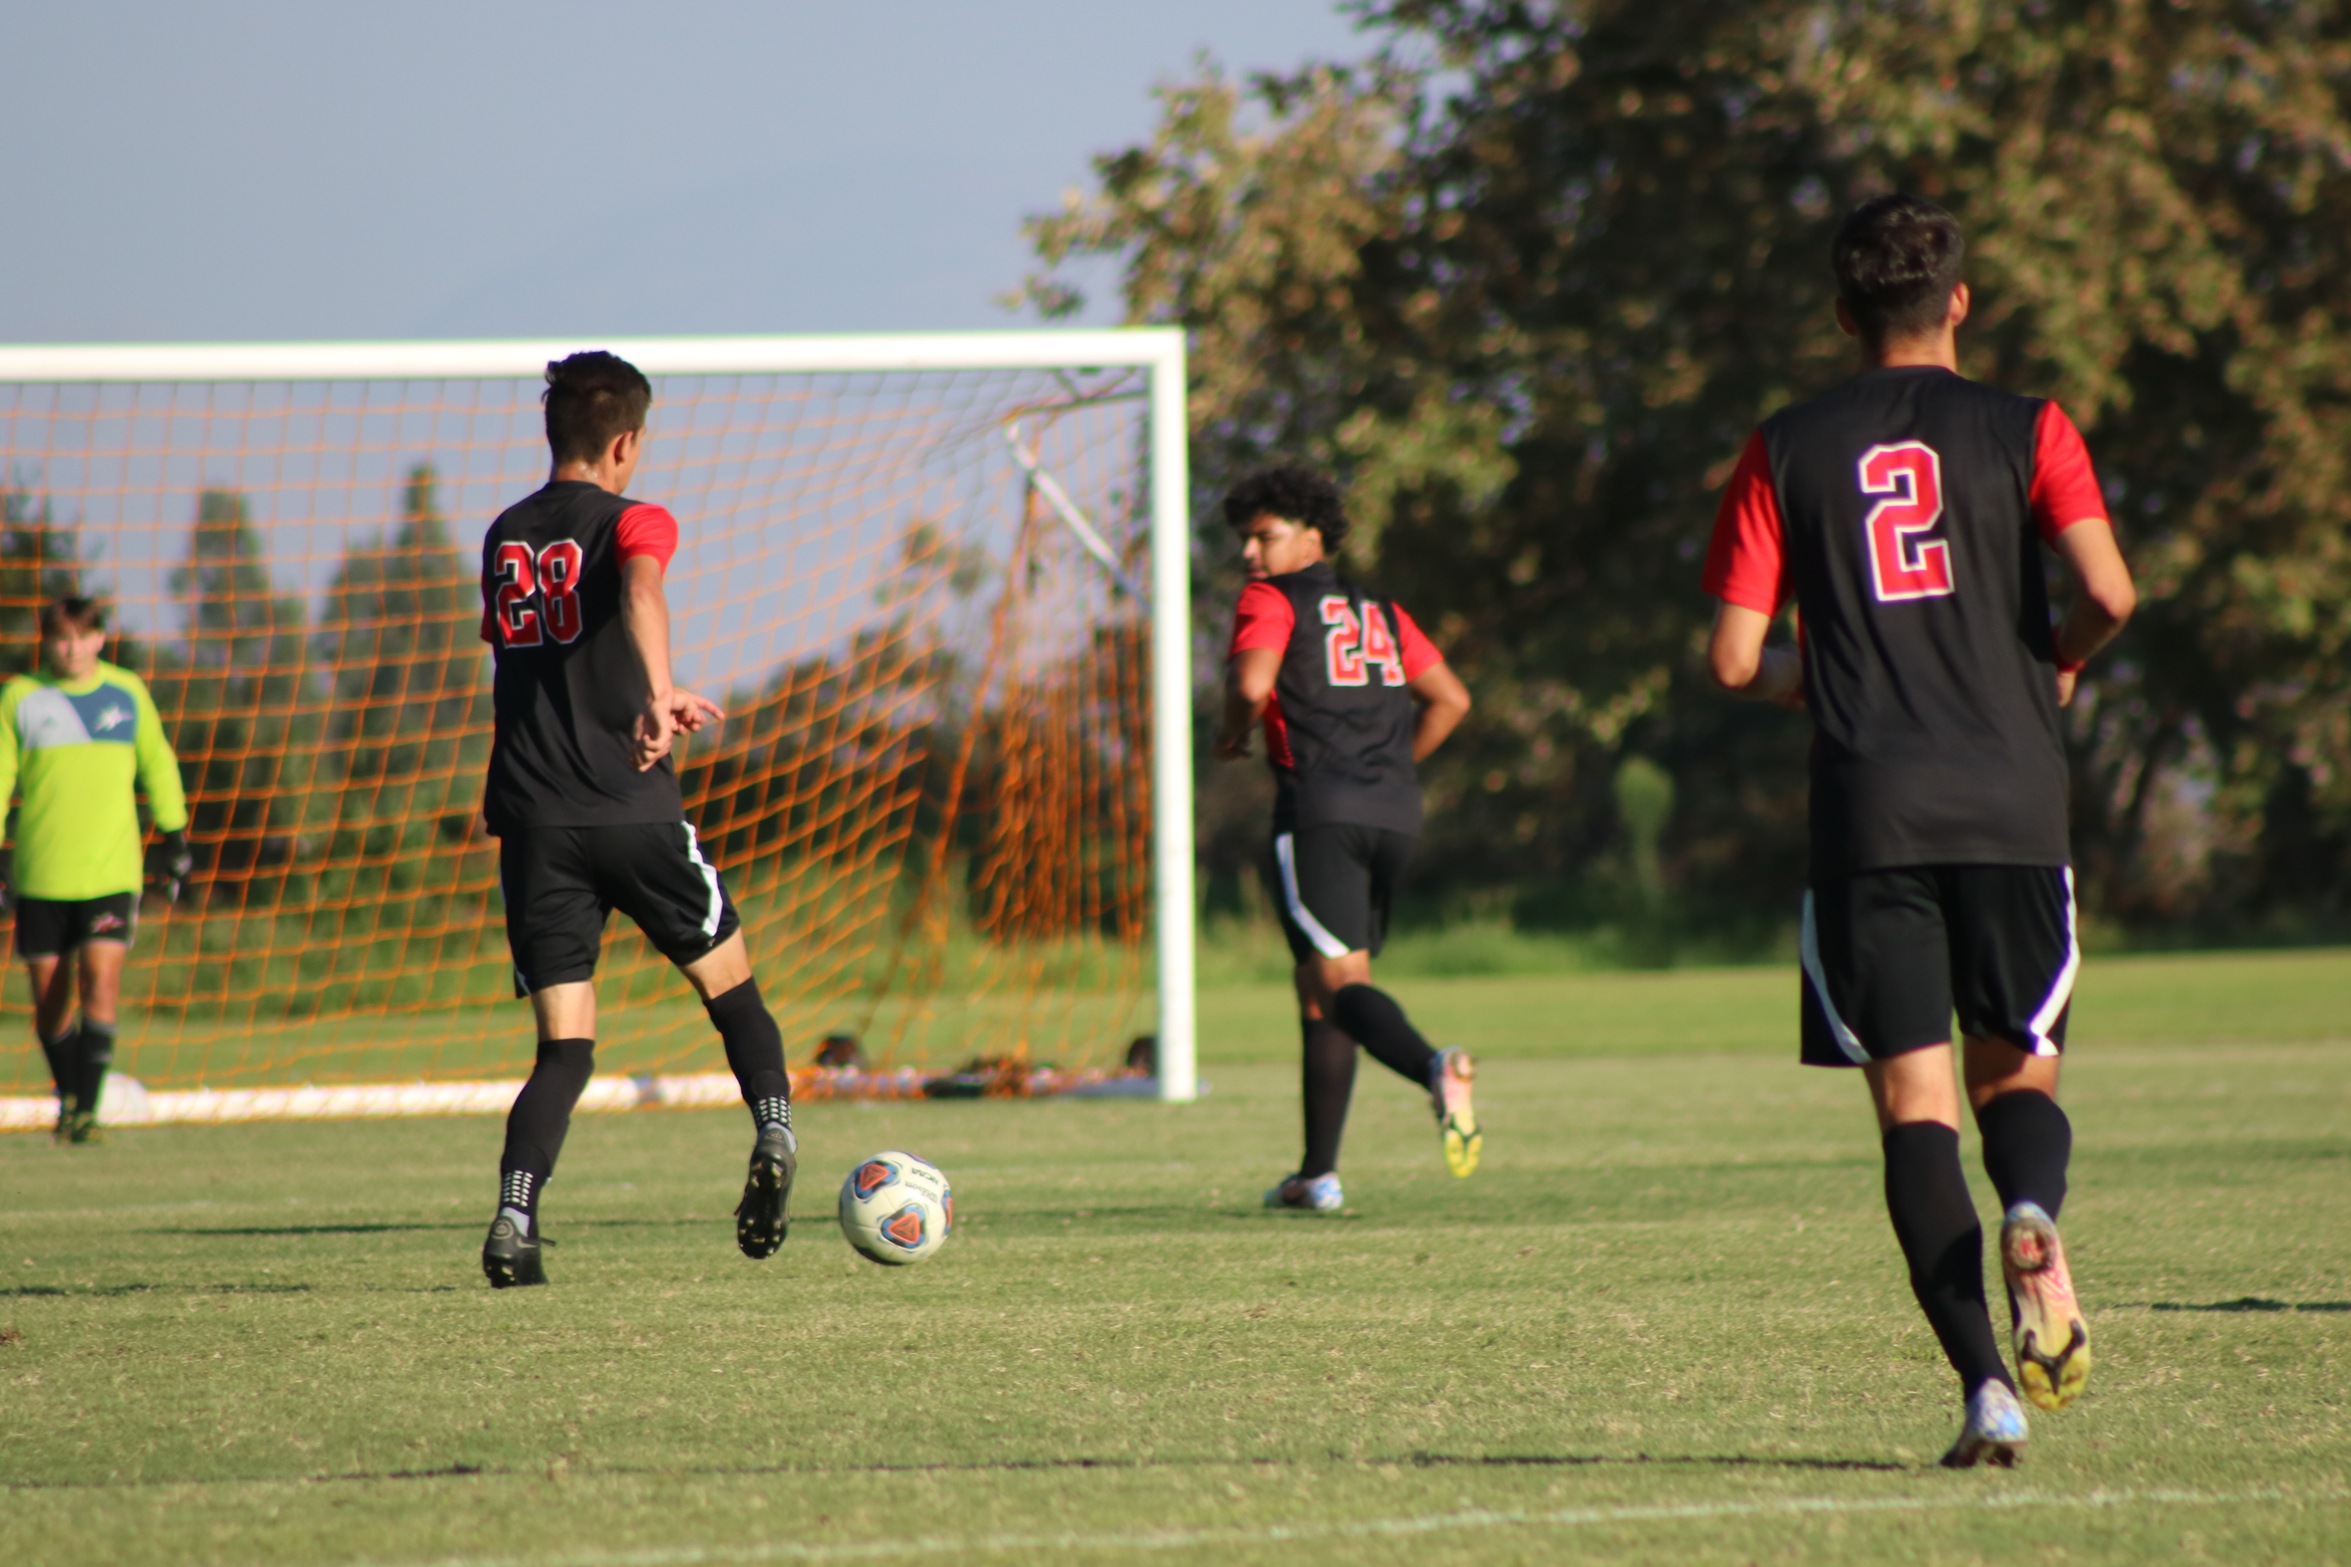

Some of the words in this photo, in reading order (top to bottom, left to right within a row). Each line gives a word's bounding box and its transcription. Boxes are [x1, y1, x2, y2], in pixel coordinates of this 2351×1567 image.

[1858, 440, 1955, 602] 2
[494, 538, 583, 649] 28
[1318, 595, 1407, 687] 24
